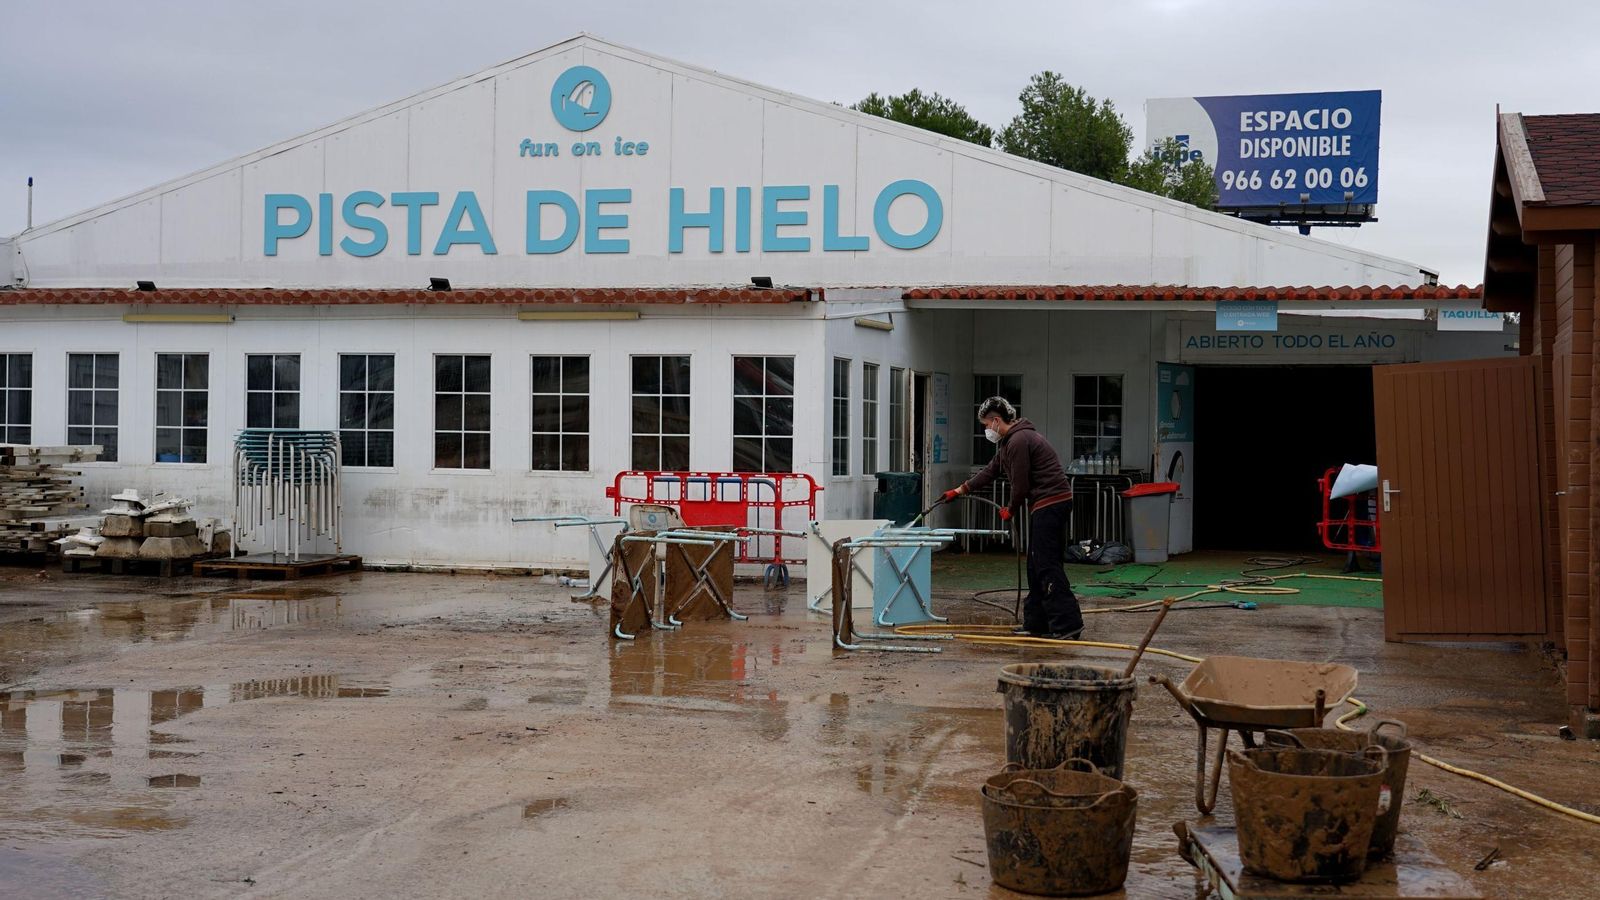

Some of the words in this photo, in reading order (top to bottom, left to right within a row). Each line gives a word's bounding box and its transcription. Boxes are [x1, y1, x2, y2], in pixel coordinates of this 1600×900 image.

[1240, 108, 1352, 132] ESPACIO
[519, 138, 559, 157] fun
[571, 141, 602, 156] on
[613, 136, 649, 156] ice
[1239, 135, 1351, 159] DISPONIBLE
[1222, 170, 1262, 190] 966
[1270, 169, 1297, 189] 62
[1305, 167, 1333, 188] 00
[1340, 166, 1368, 188] 06
[263, 190, 498, 257] PISTA
[525, 188, 632, 255] DE
[668, 179, 944, 253] HIELO
[1442, 310, 1499, 319] TAQUILLA
[1186, 335, 1263, 349] ABIERTO
[1272, 335, 1323, 349] TODO
[1328, 335, 1349, 348] EL
[1353, 331, 1395, 348] AÑO
